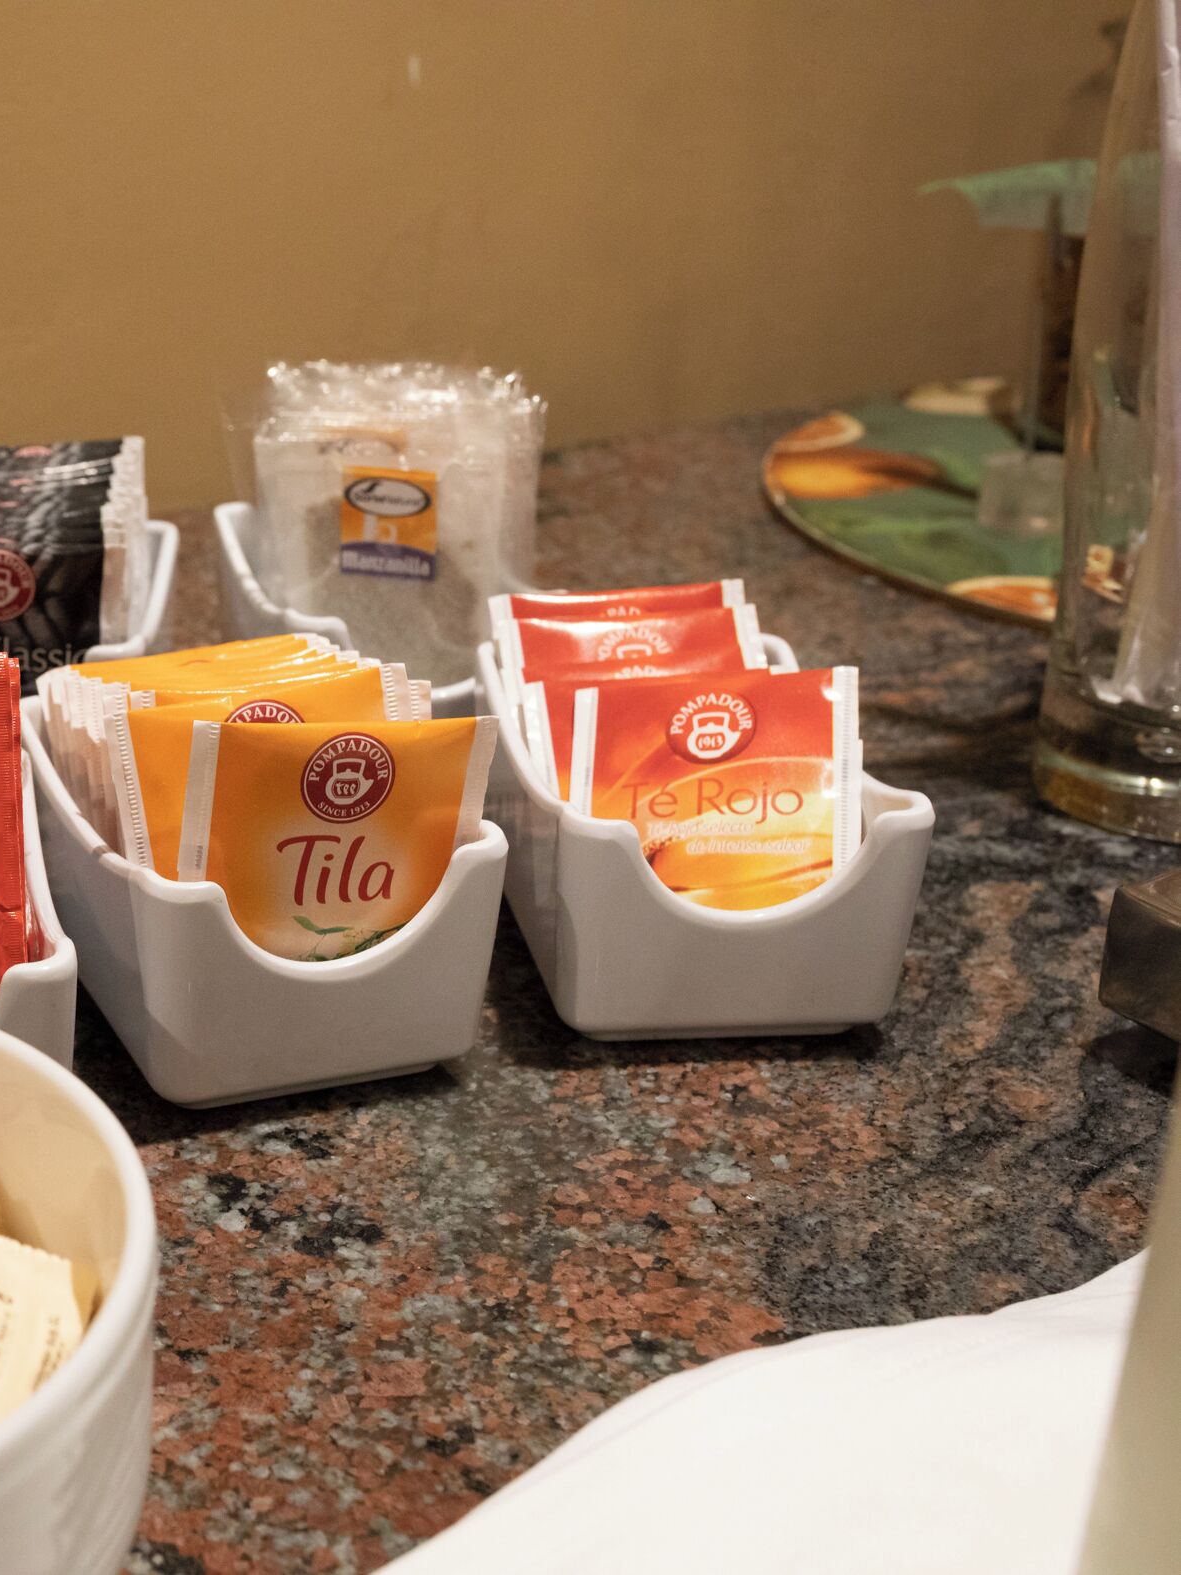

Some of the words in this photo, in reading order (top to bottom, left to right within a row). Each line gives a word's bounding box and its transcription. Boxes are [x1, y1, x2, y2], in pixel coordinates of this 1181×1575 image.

[670, 693, 753, 735] POMPADOUR
[308, 739, 389, 782] POMPADOUR
[317, 801, 348, 817] SINCE
[350, 801, 371, 815] 1913
[622, 780, 679, 821] Té
[696, 776, 804, 825] Rojo
[276, 835, 395, 906] Tila
